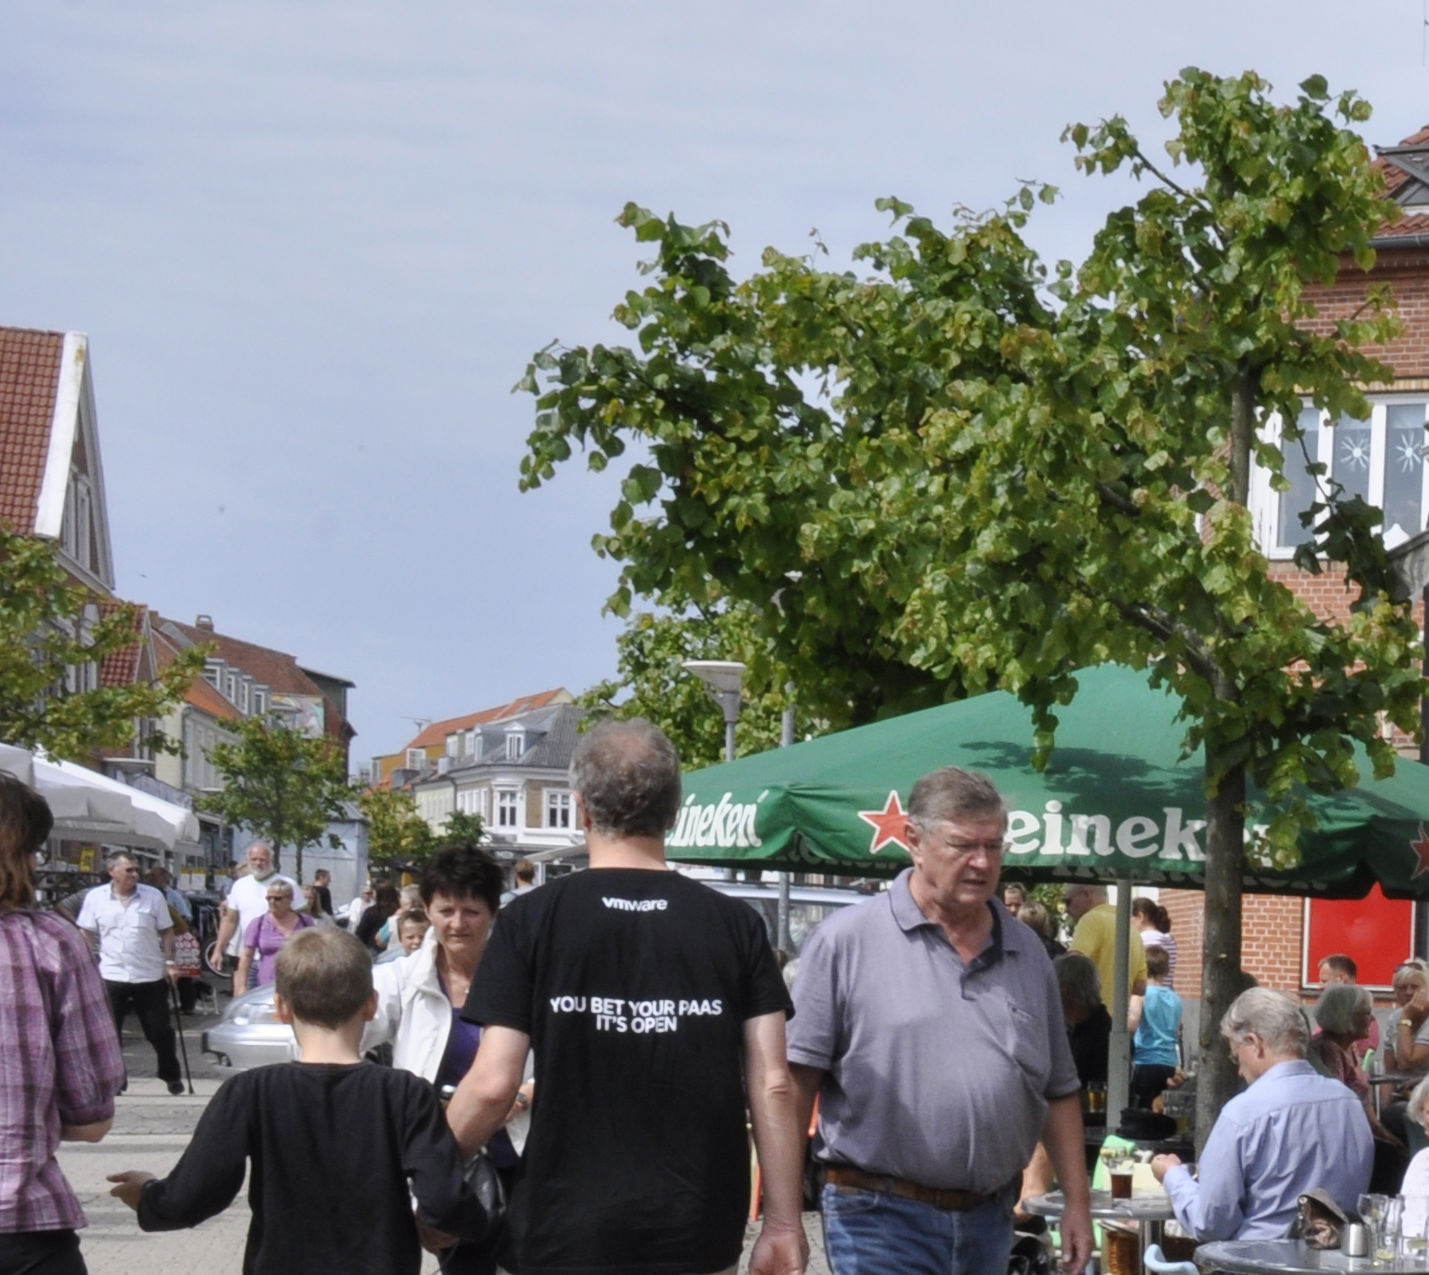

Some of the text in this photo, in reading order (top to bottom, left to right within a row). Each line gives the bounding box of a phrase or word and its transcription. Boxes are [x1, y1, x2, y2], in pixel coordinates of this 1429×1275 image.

[664, 791, 763, 848] ineken
[602, 897, 668, 912] vmware
[550, 996, 722, 1016] YOU BET YOUR PAAS
[596, 1015, 677, 1033] IT'S OPEN
